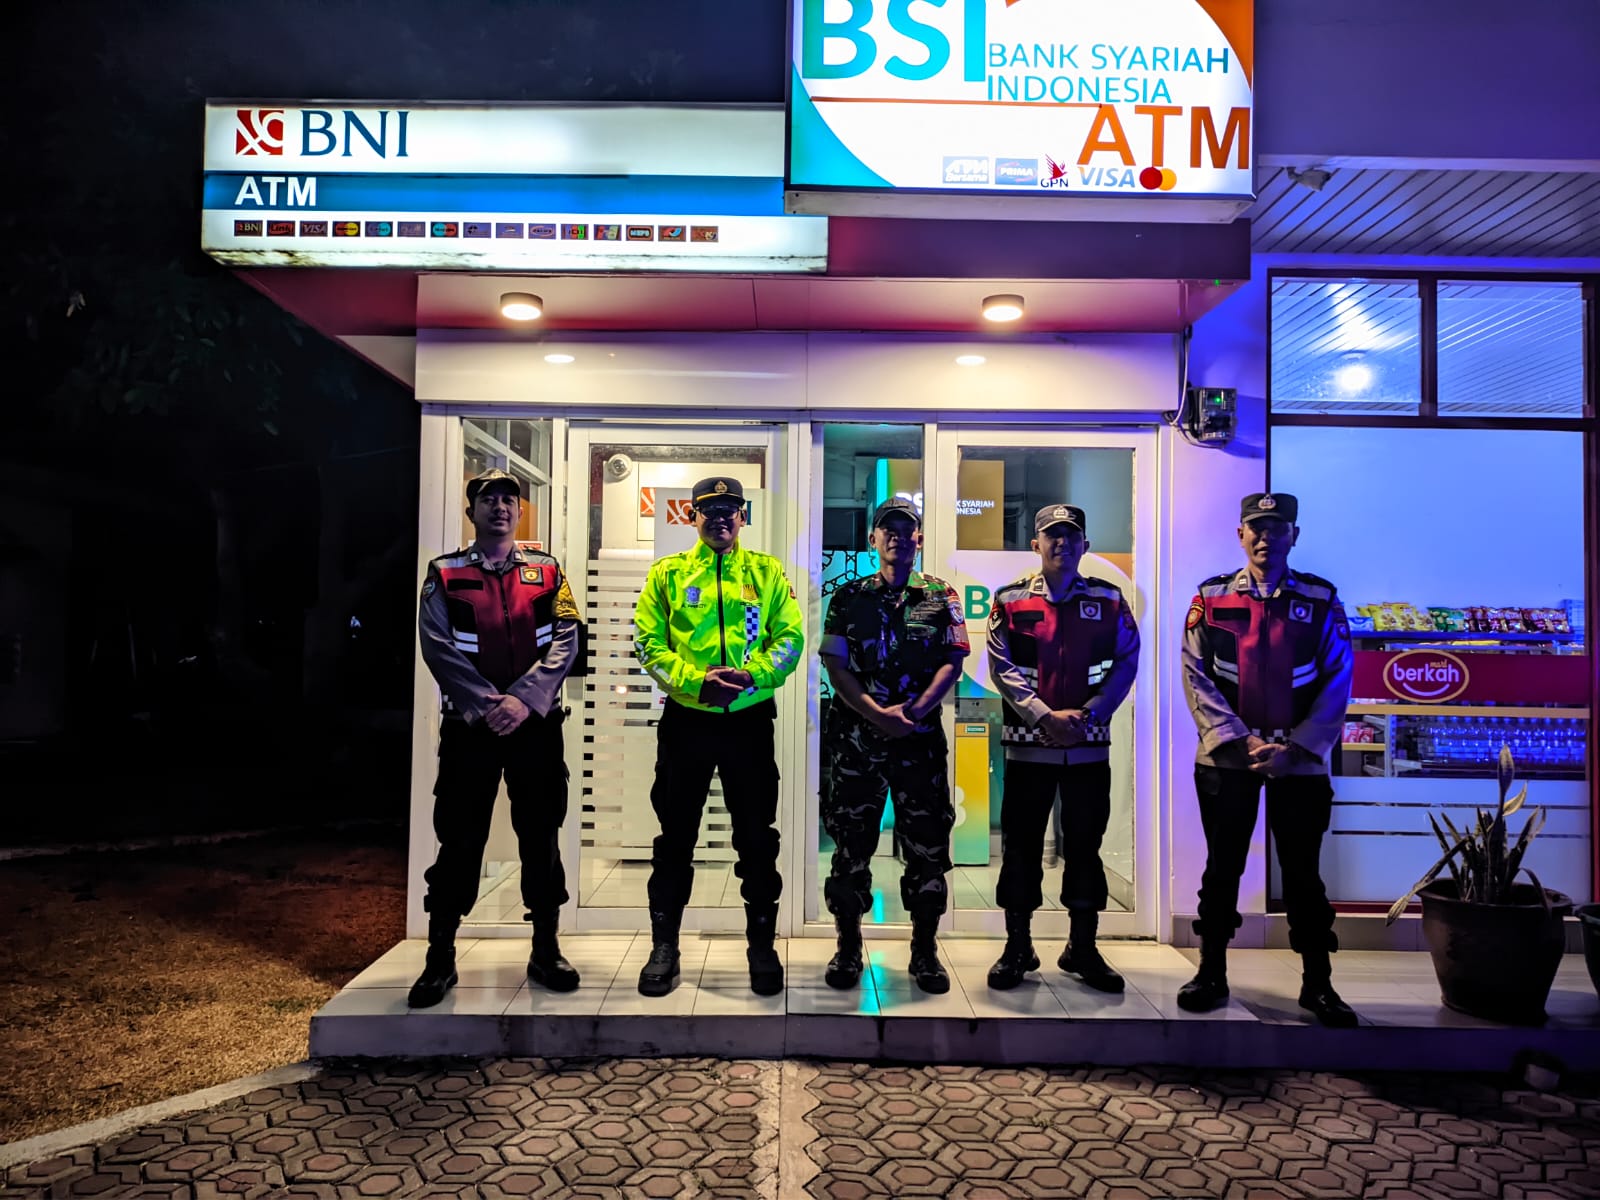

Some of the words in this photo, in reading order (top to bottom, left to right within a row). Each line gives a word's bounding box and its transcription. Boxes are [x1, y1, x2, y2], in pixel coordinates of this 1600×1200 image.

[802, 0, 986, 82] BSI
[988, 43, 1079, 69] BANK
[1091, 43, 1229, 74] SYARIAH
[987, 75, 1172, 104] INDONESIA
[300, 109, 411, 159] BNI
[1076, 104, 1251, 169] ATM
[999, 167, 1034, 177] PRIMA
[1040, 178, 1069, 188] GPN
[1076, 166, 1136, 188] VISA
[234, 176, 317, 206] ATM
[303, 223, 327, 233] VISA
[961, 500, 995, 508] SYARIAH
[1393, 662, 1460, 683] berkah
